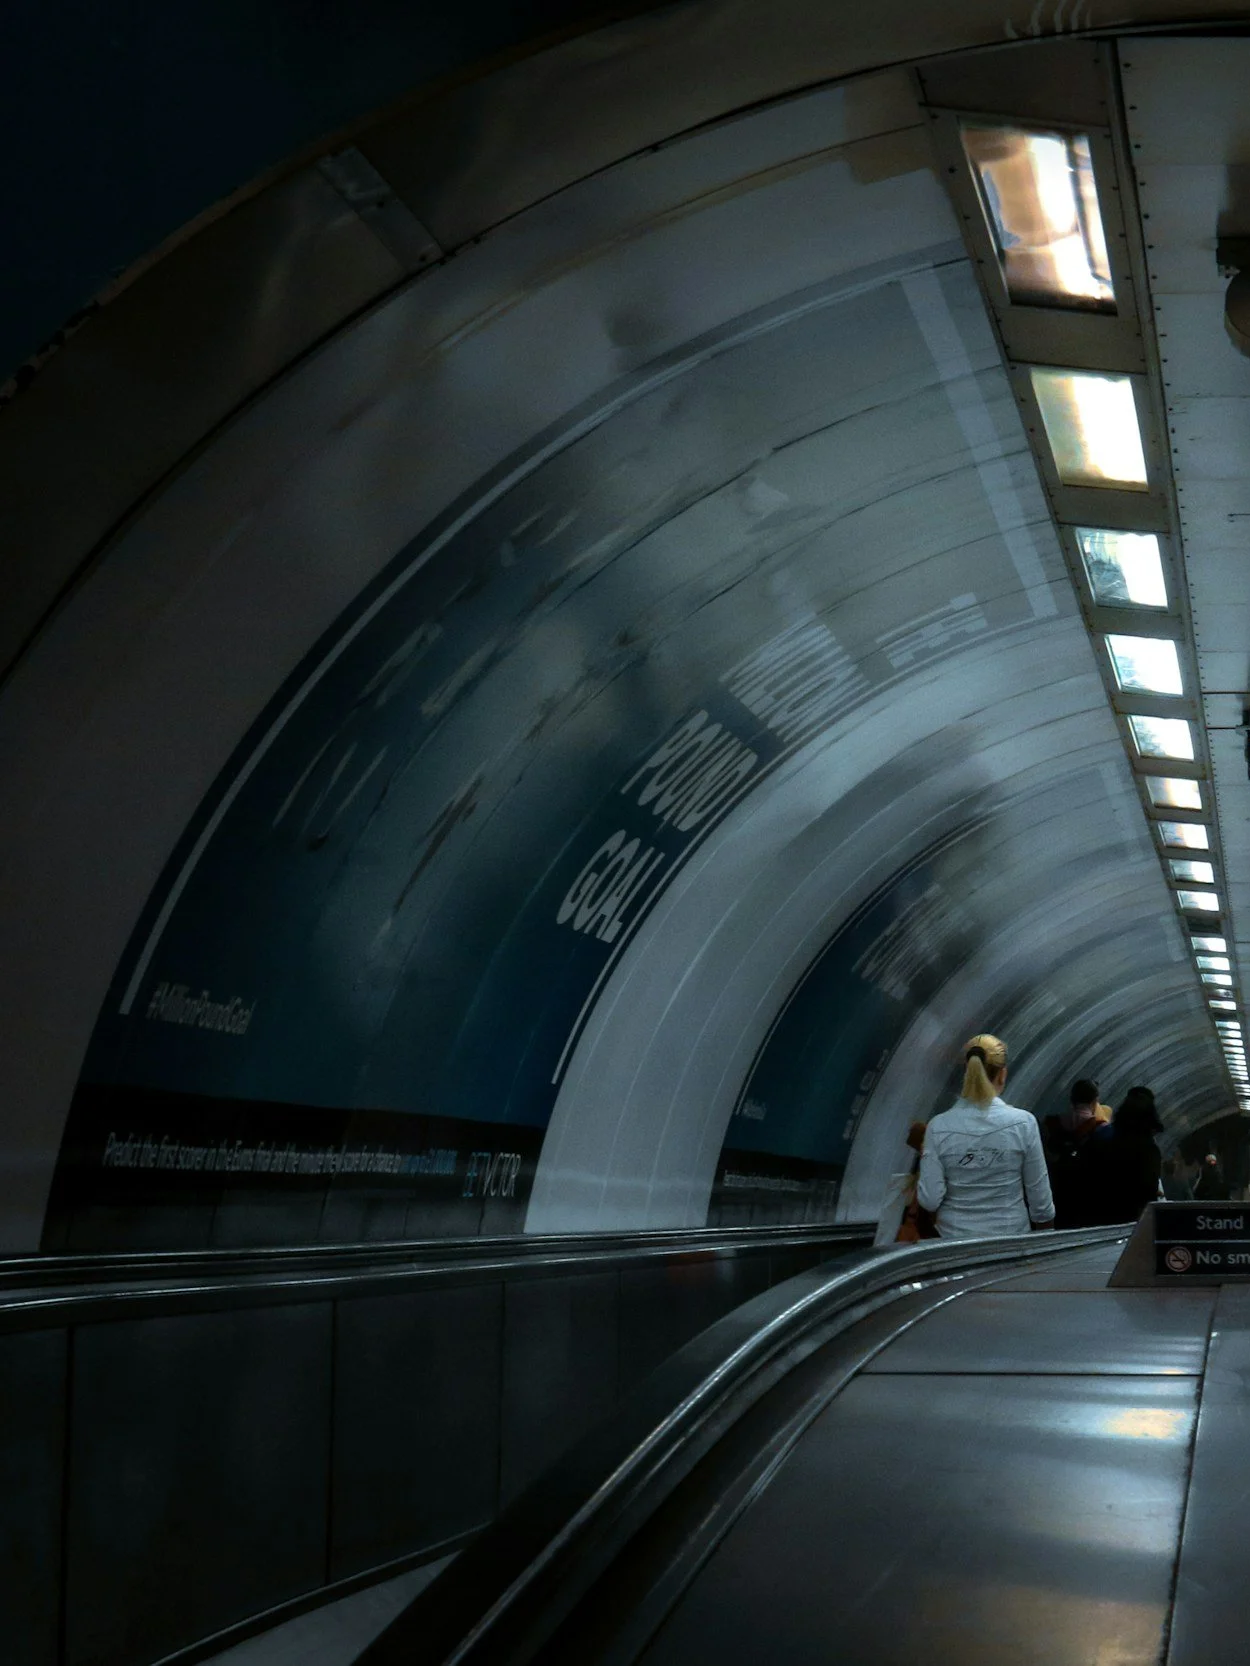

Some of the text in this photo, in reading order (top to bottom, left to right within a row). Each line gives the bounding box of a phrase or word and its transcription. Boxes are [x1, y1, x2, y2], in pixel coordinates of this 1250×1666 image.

[718, 612, 872, 743] MILLION
[875, 592, 988, 669] THE
[620, 709, 758, 832] POUND
[556, 828, 665, 943] GOAL
[1196, 1213, 1244, 1230] Stand
[1196, 1250, 1221, 1265] No
